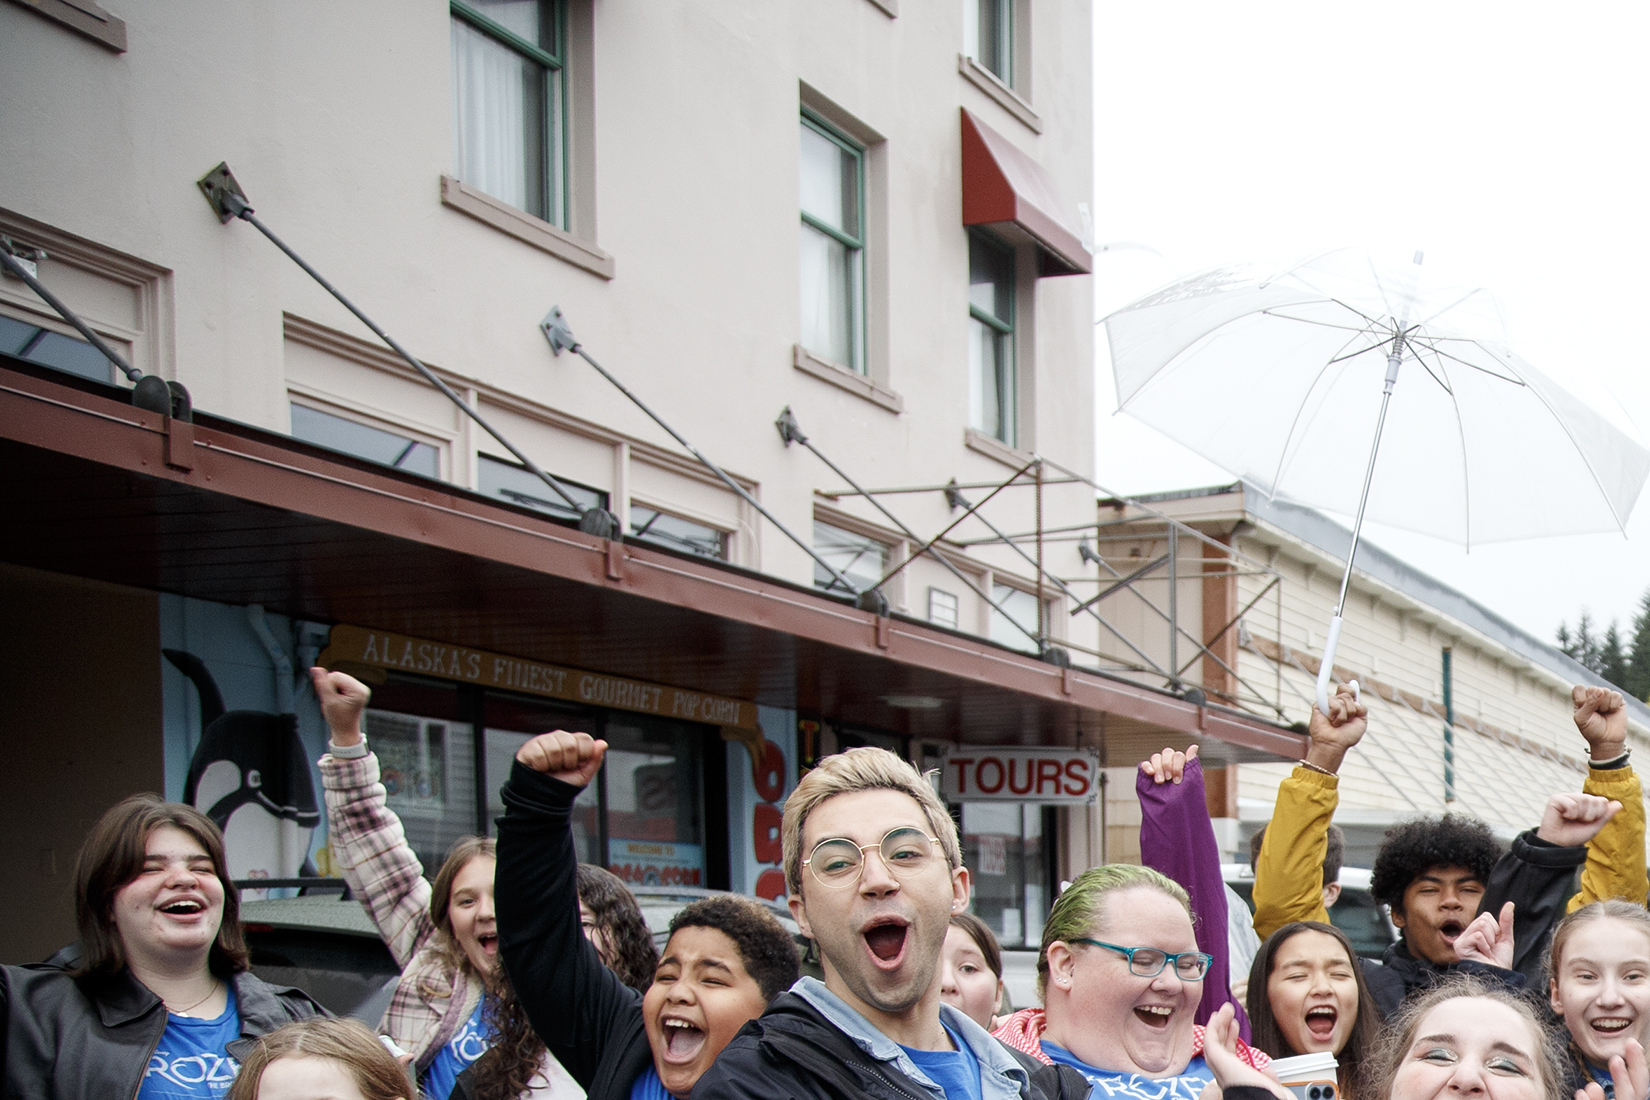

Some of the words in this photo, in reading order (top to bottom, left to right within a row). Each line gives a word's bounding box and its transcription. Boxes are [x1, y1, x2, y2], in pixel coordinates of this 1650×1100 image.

[362, 634, 482, 680] ALASKA'S
[492, 657, 567, 693] FINEST
[579, 674, 664, 713] GOURMET
[949, 756, 1091, 797] TOURS
